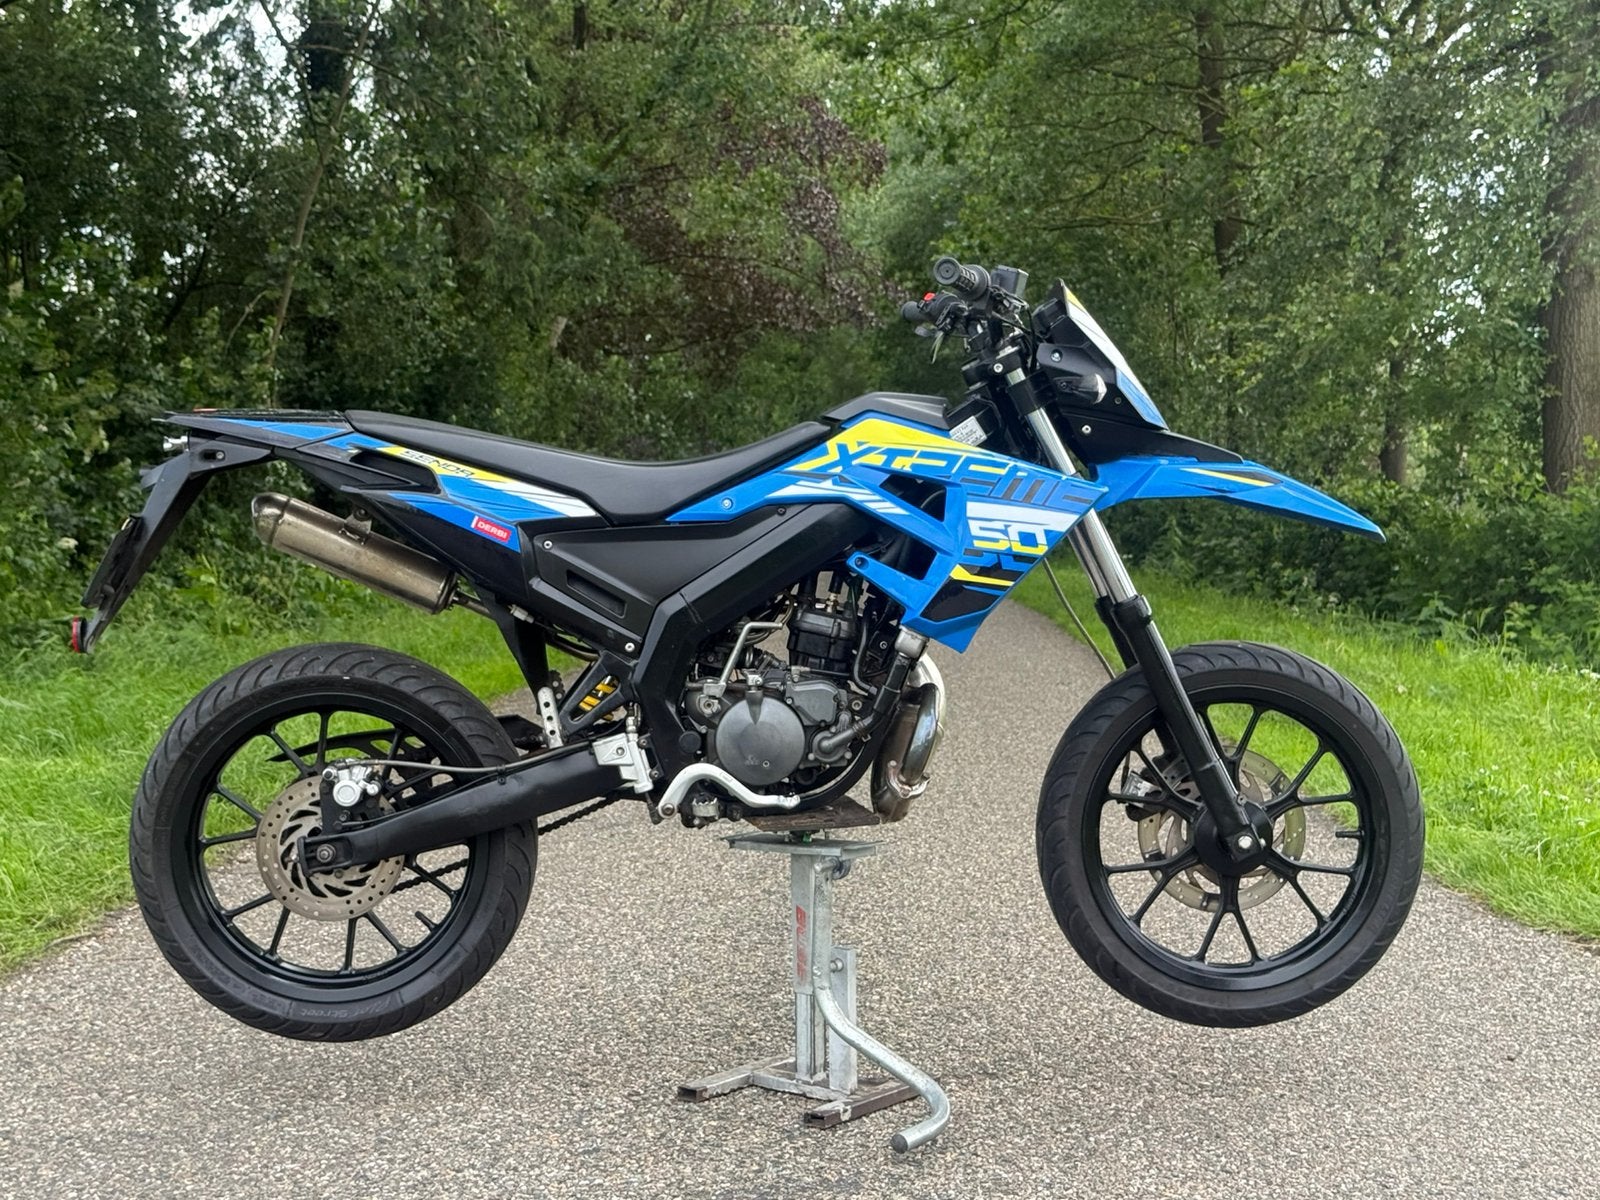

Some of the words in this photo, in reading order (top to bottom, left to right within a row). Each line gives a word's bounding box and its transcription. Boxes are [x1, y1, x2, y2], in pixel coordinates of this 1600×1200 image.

[400, 450, 475, 477] SENDA
[477, 521, 507, 539] DERBI
[968, 519, 1048, 555] 50
